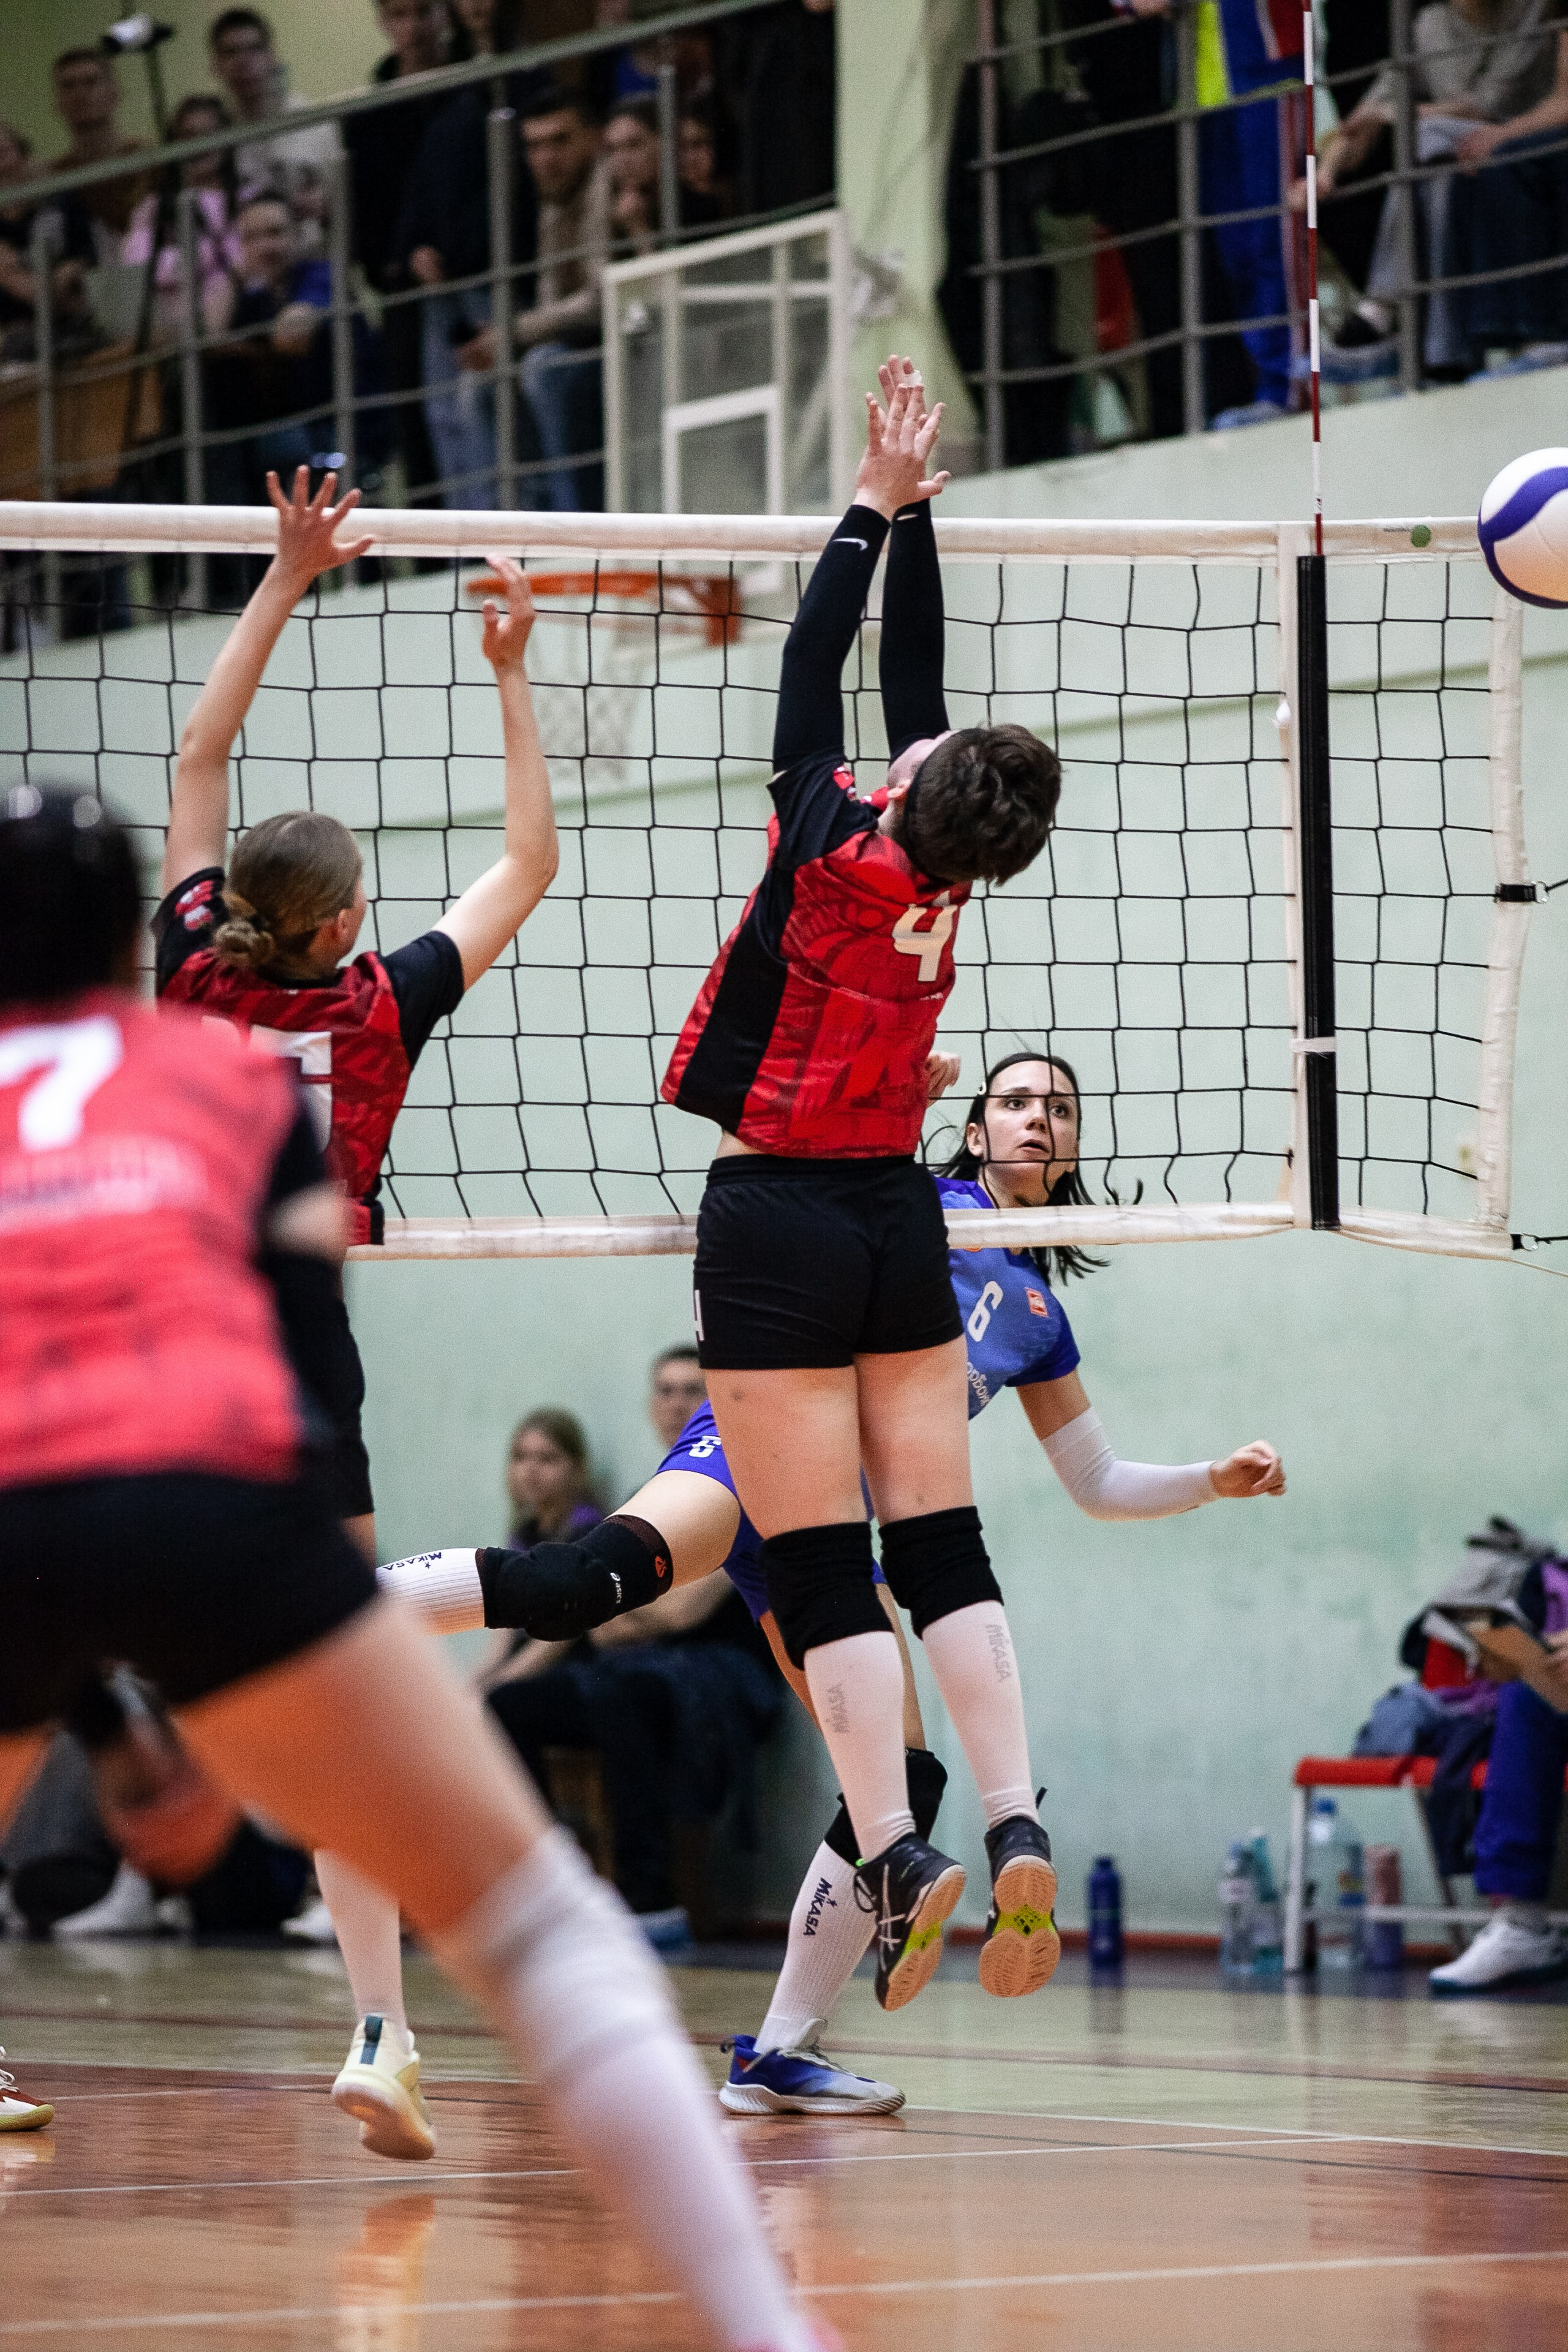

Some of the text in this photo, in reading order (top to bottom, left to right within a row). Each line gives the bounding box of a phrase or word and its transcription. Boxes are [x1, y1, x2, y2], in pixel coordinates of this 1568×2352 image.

[892, 890, 958, 982] 4
[0, 1012, 123, 1152] 7
[967, 1281, 1004, 1342] 6
[689, 1435, 722, 1458] 6
[382, 1551, 442, 1570] MIKASA
[803, 1877, 833, 1936] MIKASA
